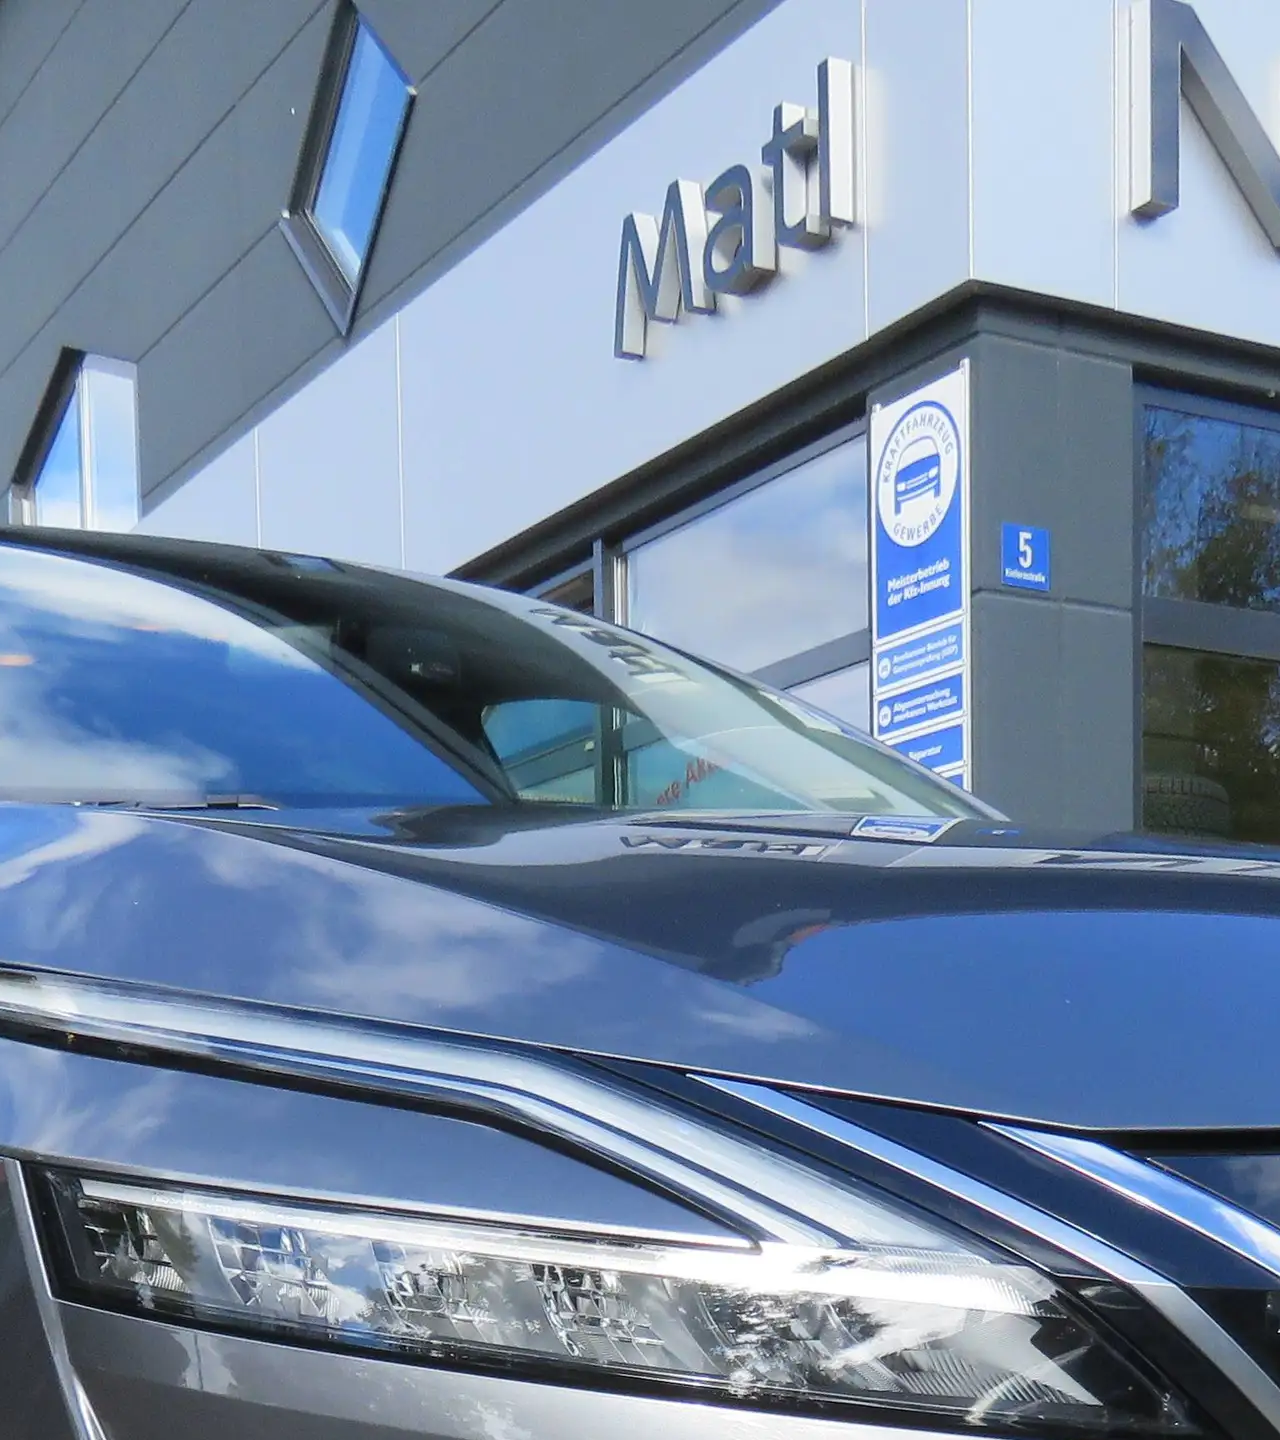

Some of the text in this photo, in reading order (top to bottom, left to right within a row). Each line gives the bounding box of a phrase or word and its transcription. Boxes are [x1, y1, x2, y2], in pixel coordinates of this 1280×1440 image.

[614, 56, 854, 360] Matl
[883, 412, 954, 483] KRAFTFAHRZEUG
[893, 504, 944, 541] GEWERBE
[1019, 531, 1032, 568] 5
